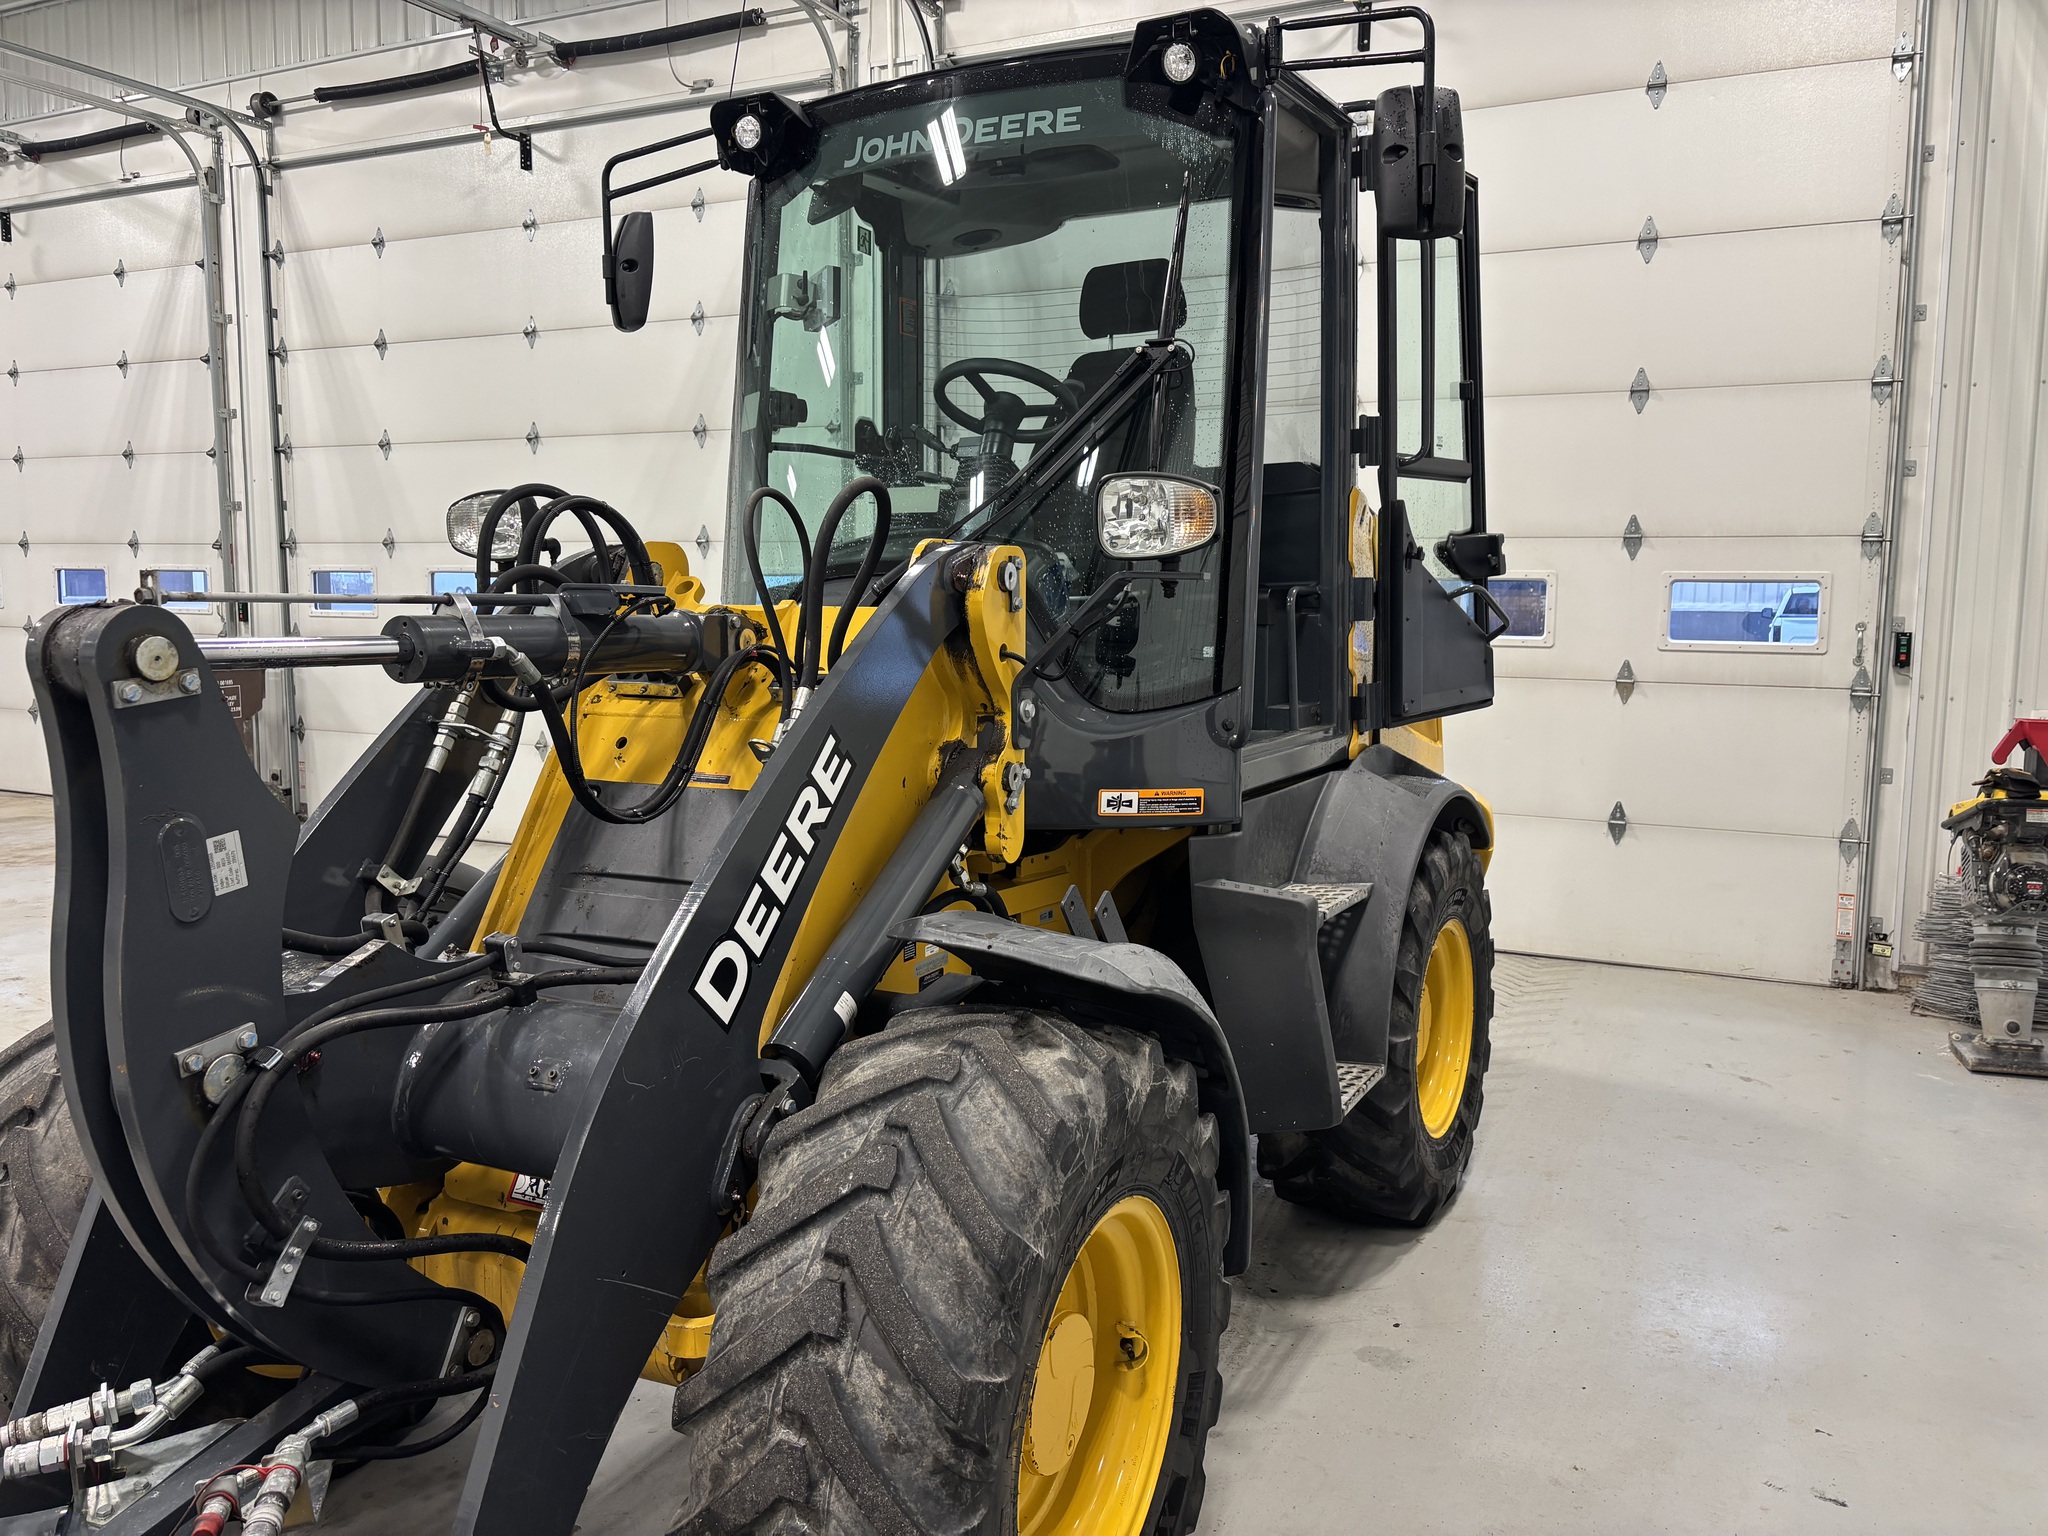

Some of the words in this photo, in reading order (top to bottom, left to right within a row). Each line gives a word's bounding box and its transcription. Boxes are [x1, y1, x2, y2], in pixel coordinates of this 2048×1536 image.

[843, 129, 935, 169] JOHN
[950, 105, 1083, 145] DEERE
[693, 733, 852, 1026] DEERE
